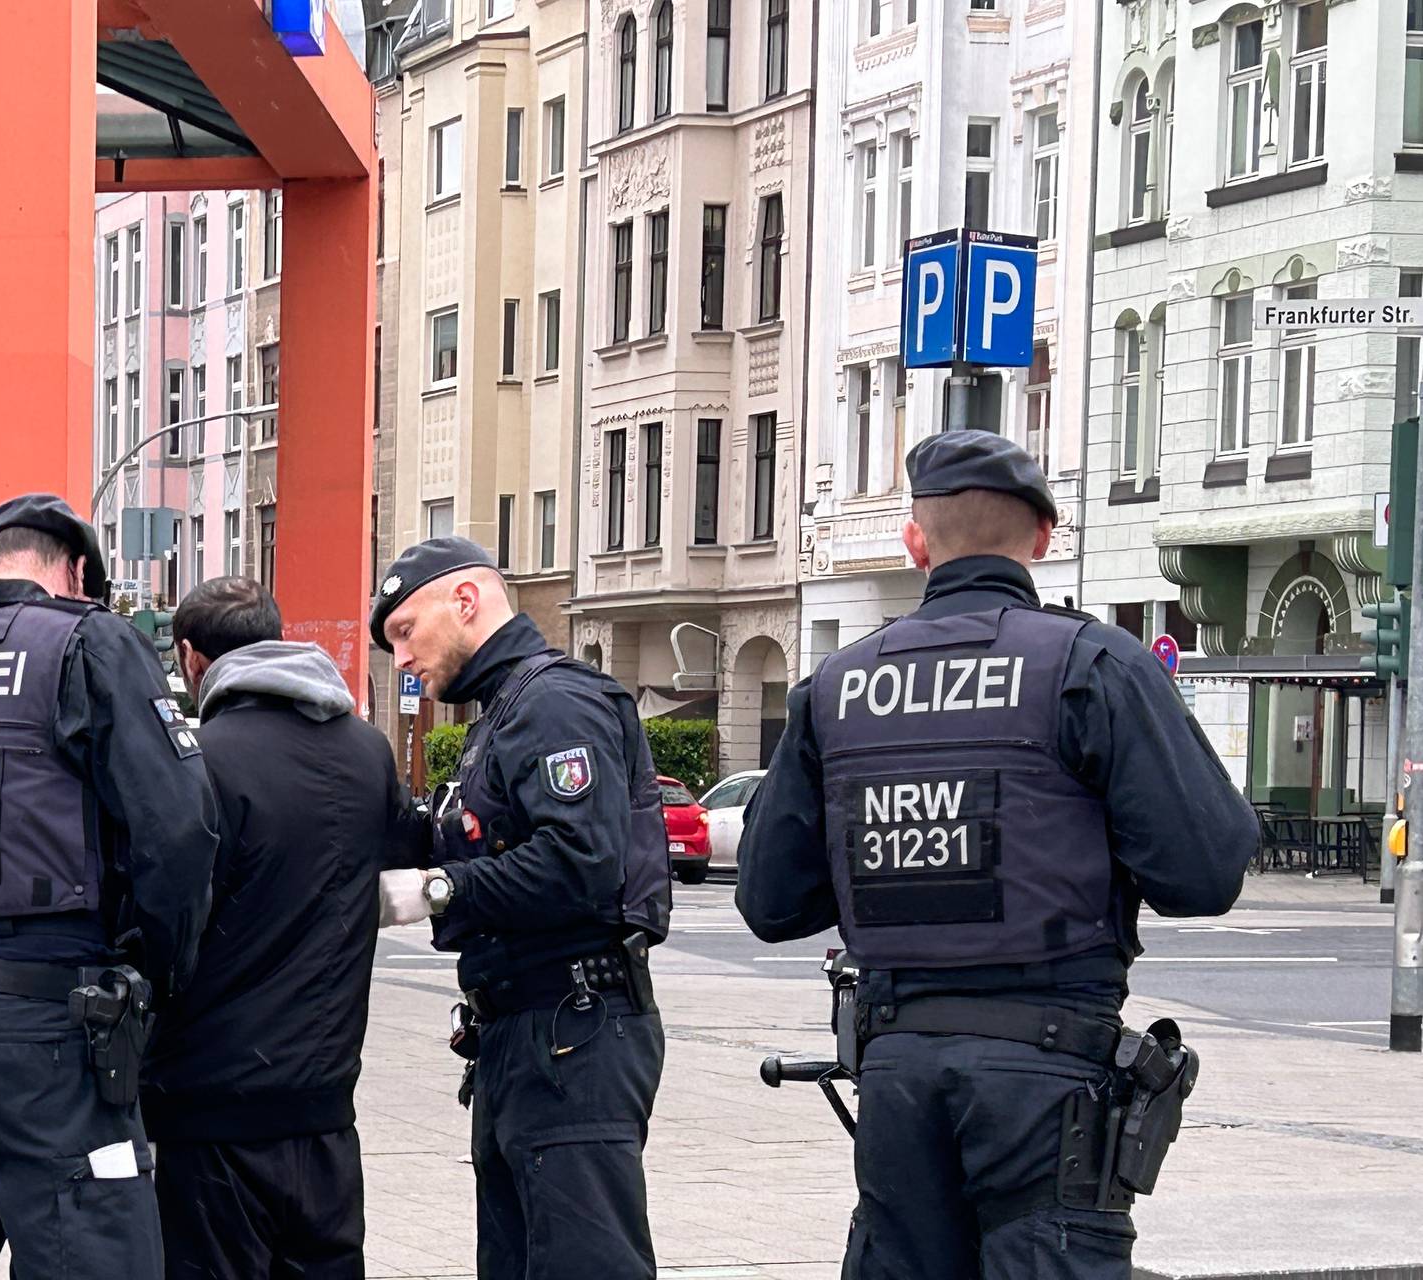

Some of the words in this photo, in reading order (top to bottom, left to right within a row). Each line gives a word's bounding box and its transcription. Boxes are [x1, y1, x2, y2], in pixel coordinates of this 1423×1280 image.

[917, 261, 945, 352] P
[982, 259, 1021, 350] P
[1265, 306, 1375, 325] Frankfurter
[1381, 305, 1414, 323] Str.
[403, 674, 415, 692] P
[838, 656, 1024, 720] POLIZEI
[865, 781, 965, 825] NRW
[863, 825, 968, 870] 31231
